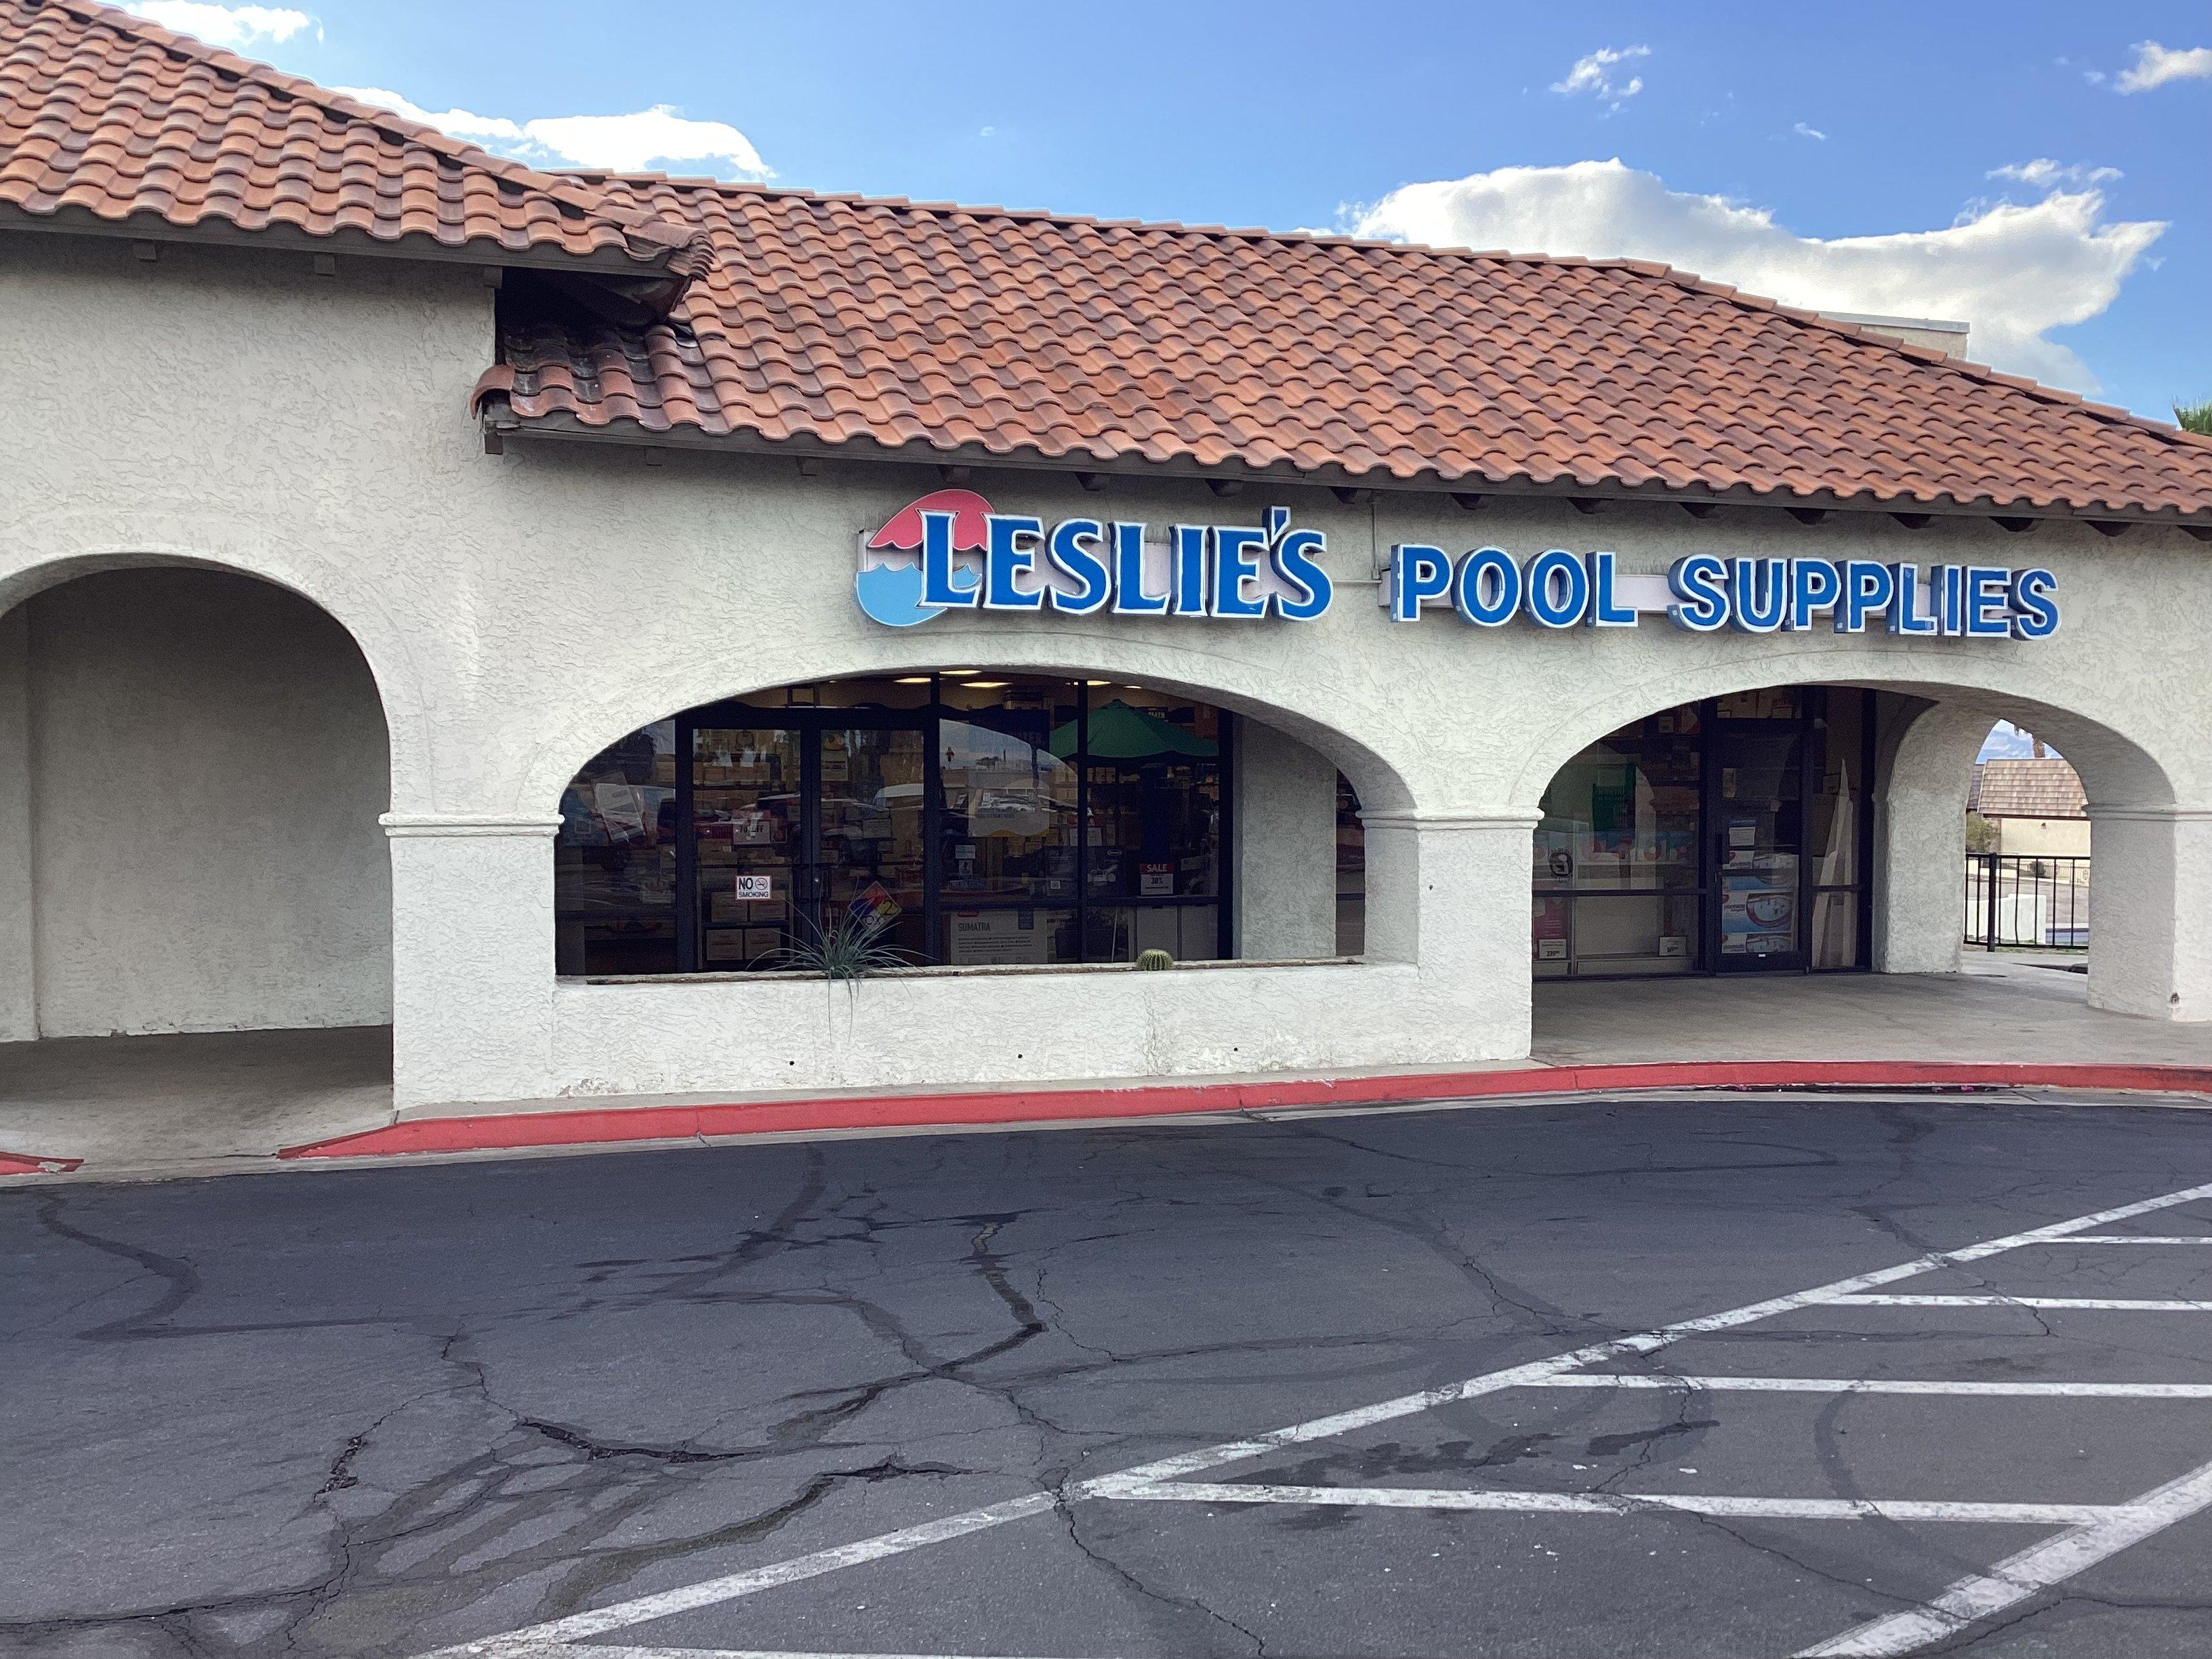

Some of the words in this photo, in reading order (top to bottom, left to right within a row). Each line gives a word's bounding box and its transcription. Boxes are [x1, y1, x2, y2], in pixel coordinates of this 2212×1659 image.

[915, 506, 1334, 622] LESLIE'S
[1391, 544, 1639, 628] POOL
[1668, 553, 2062, 641] SUPPLIES
[1147, 864, 1168, 872] SALE
[739, 878, 753, 890] NO
[958, 922, 991, 932] SUMATRA
